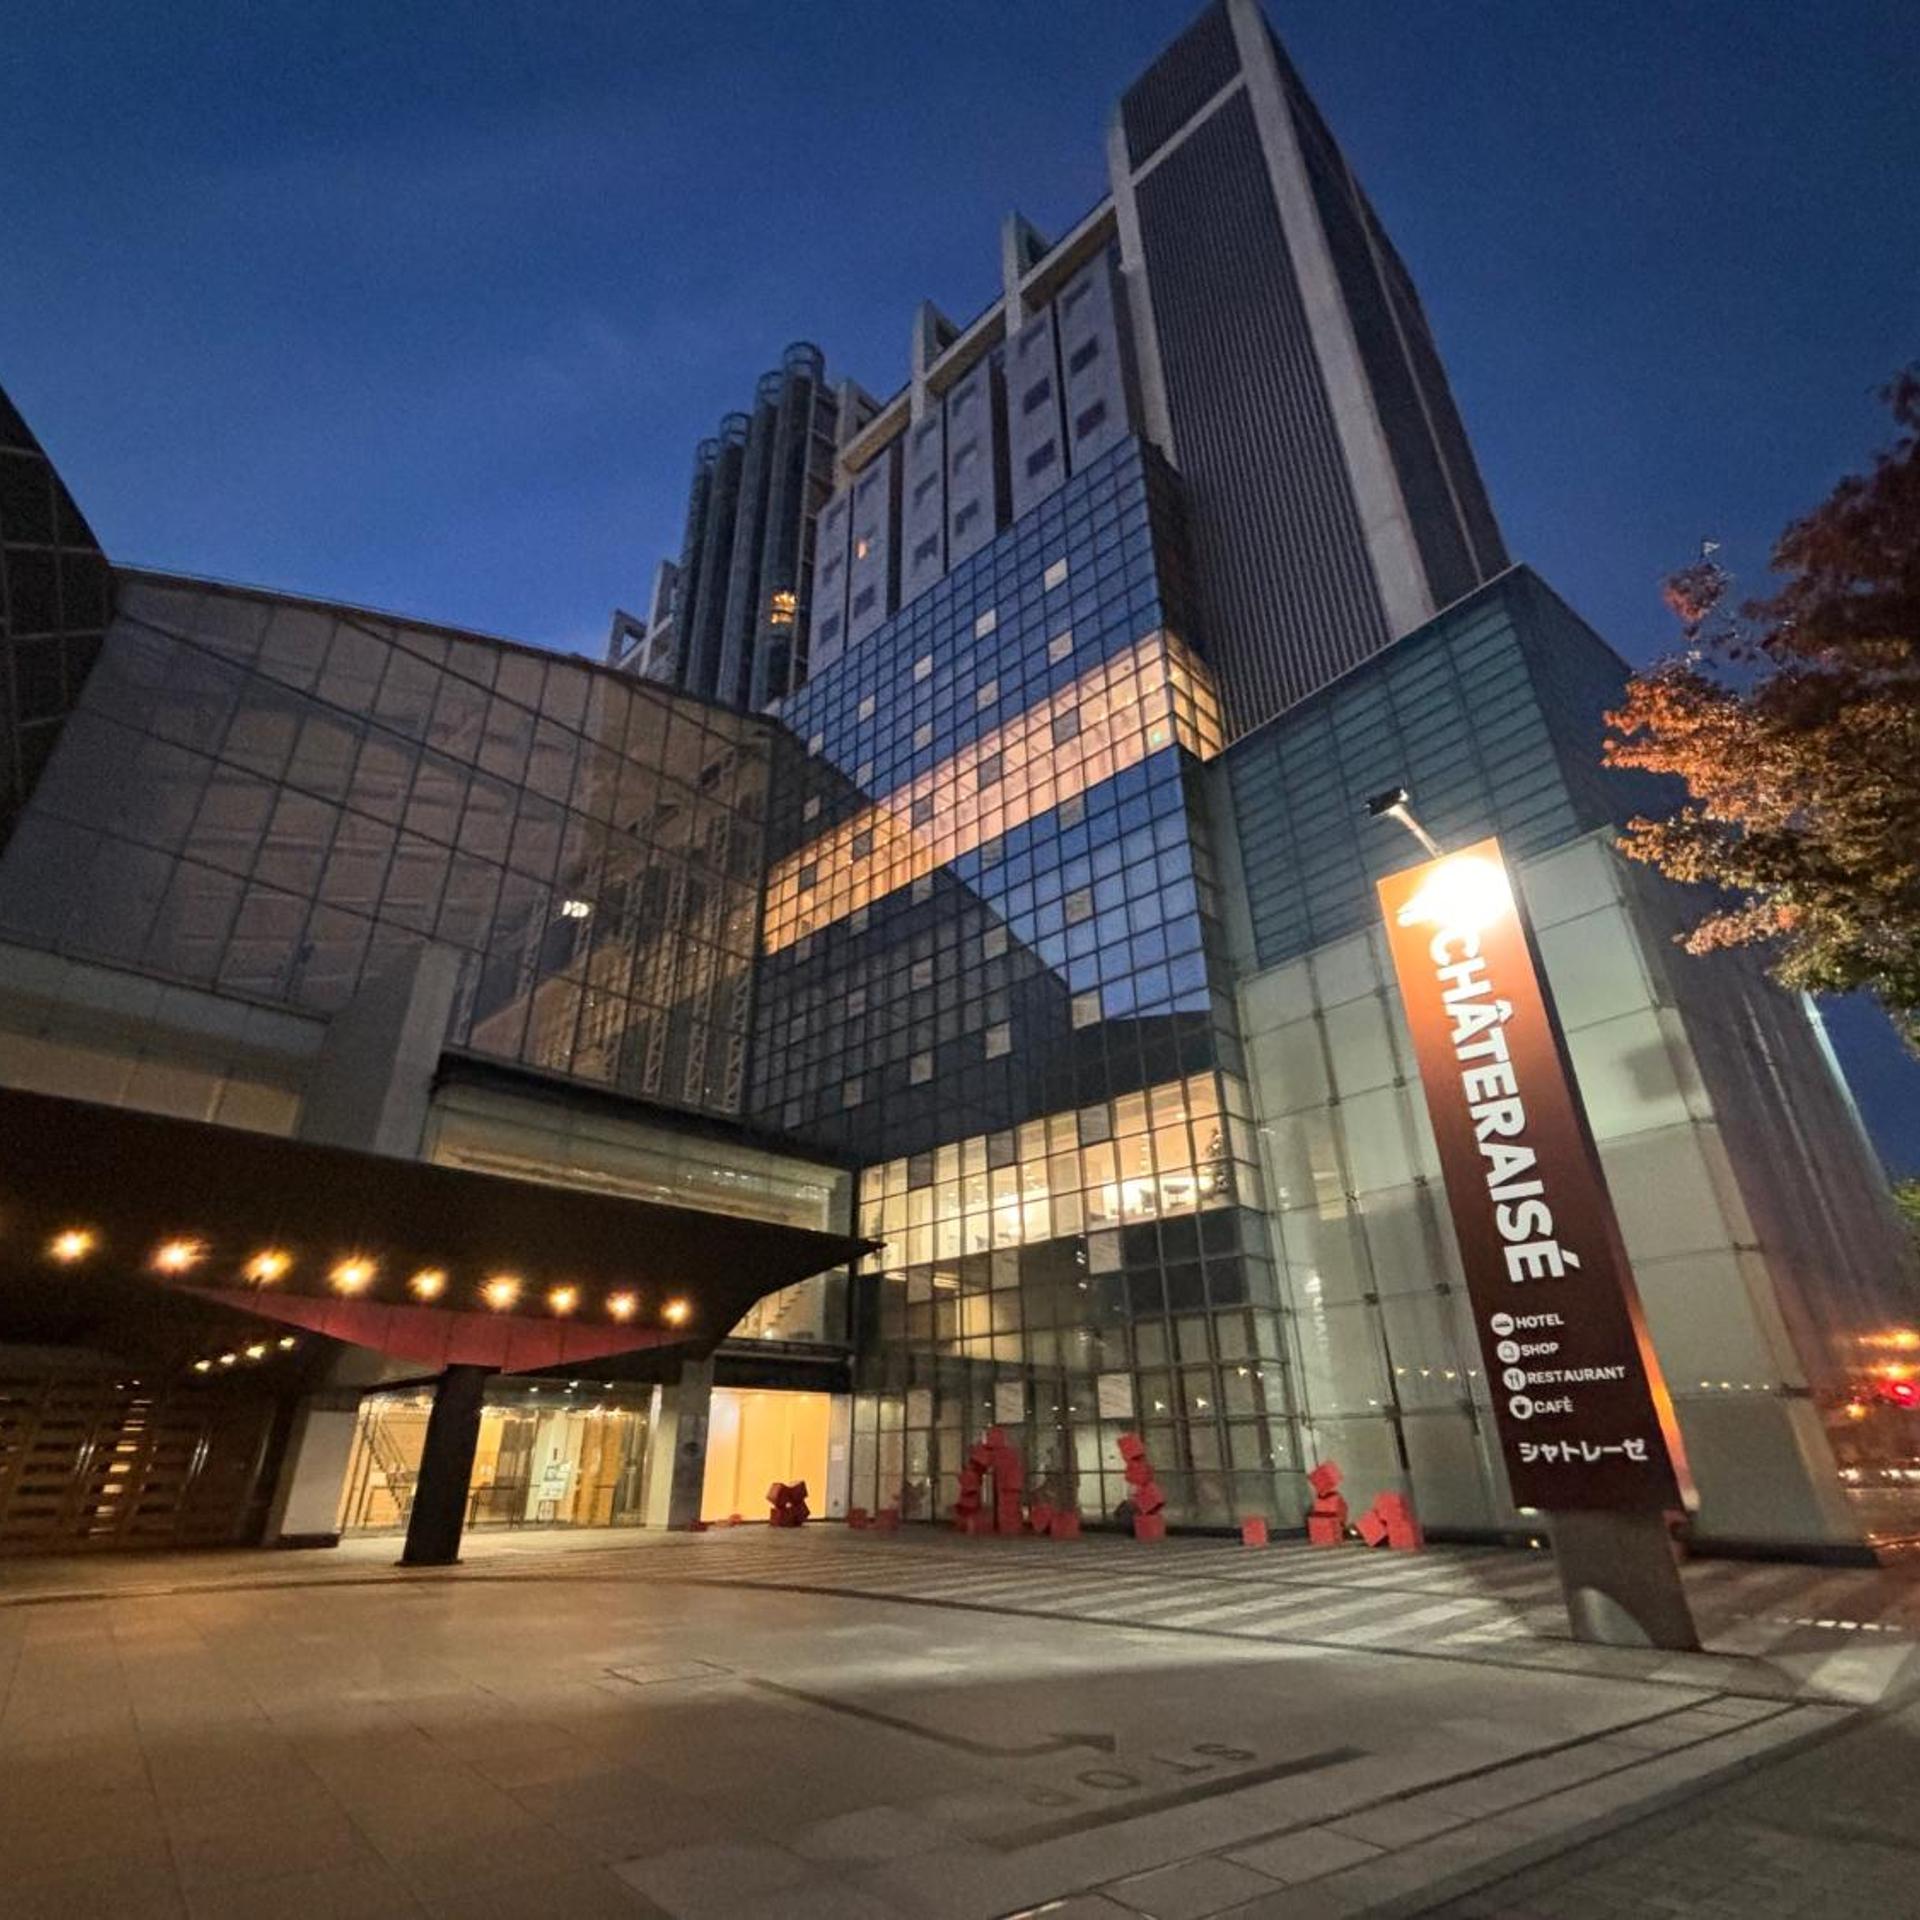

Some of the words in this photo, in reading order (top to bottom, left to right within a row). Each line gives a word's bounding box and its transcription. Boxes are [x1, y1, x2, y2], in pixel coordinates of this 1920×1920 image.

[1430, 922, 1581, 1282] CHÂTERAISÉ
[1515, 1313, 1565, 1329] HOTEL
[1521, 1342, 1559, 1357] SHOP
[1527, 1366, 1626, 1384] RESTAURANT
[1518, 1438, 1648, 1462] シャトレーゼ
